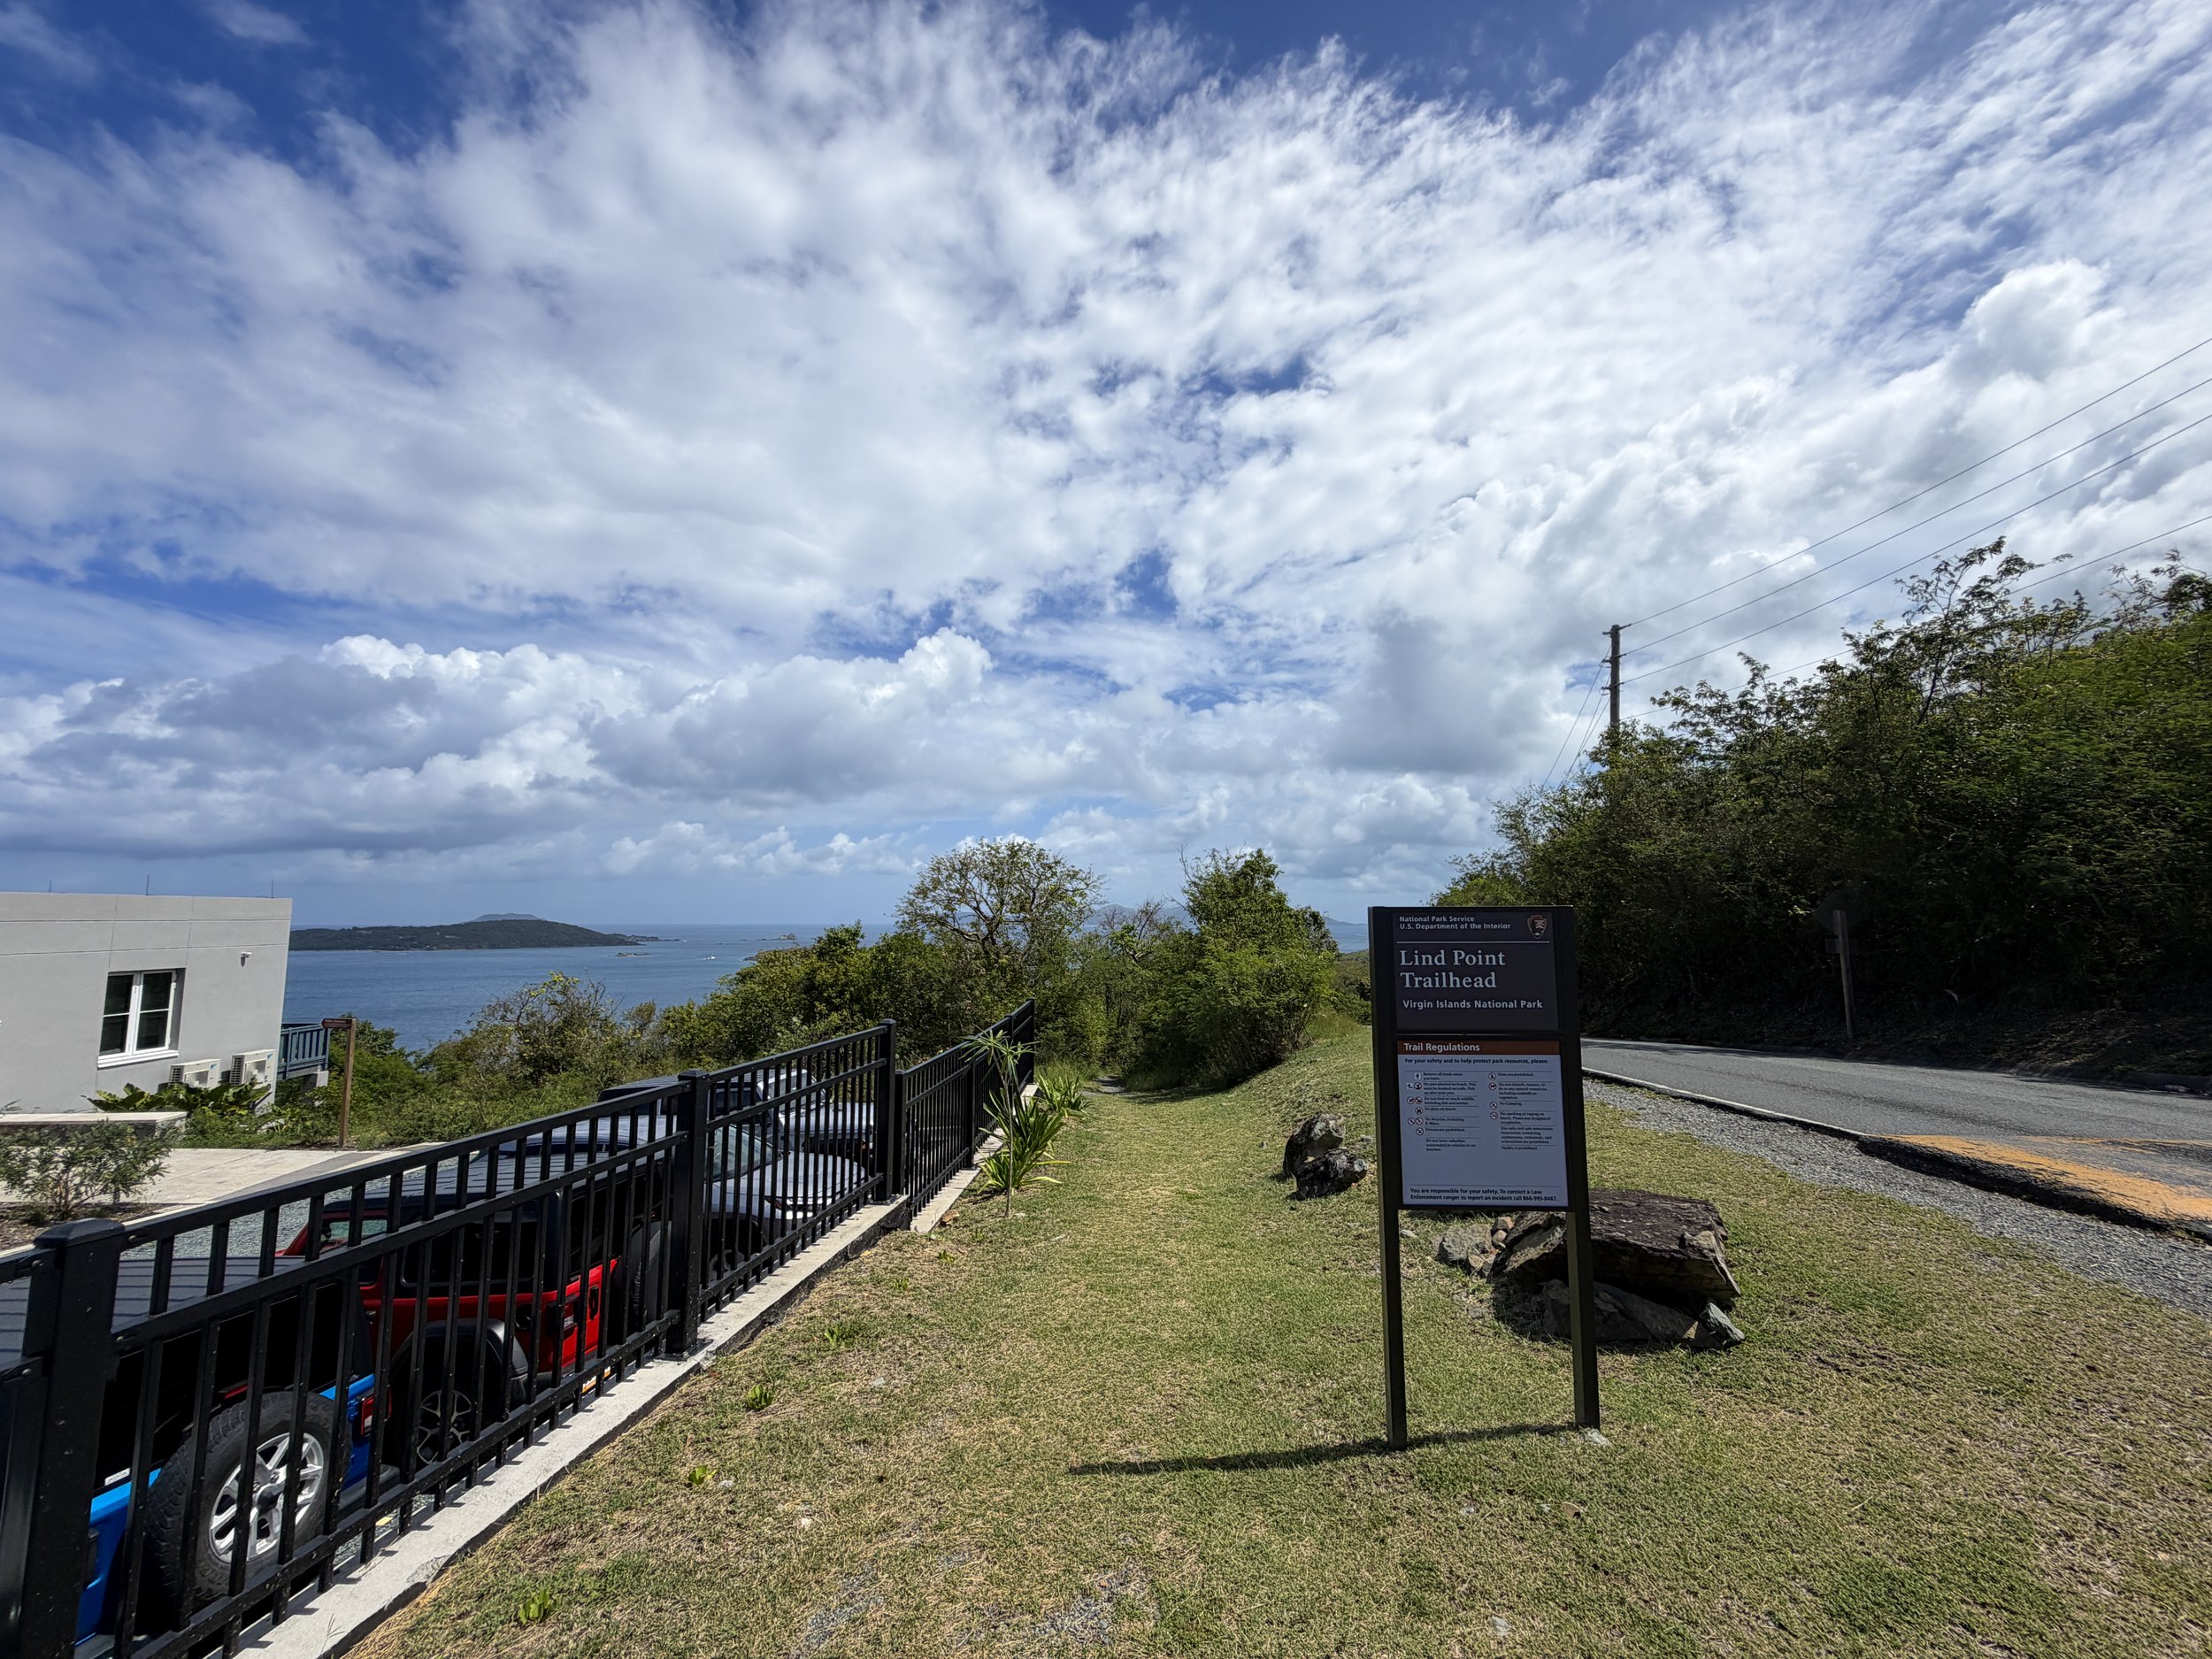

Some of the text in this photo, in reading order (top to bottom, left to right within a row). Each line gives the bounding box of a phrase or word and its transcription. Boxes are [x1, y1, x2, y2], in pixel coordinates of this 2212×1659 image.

[1400, 950, 1506, 966] Lind Point
[1400, 972, 1497, 988] Trailhead
[1403, 1000, 1542, 1010] Virgin Islands National Park
[1426, 1043, 1480, 1053] Regulations
